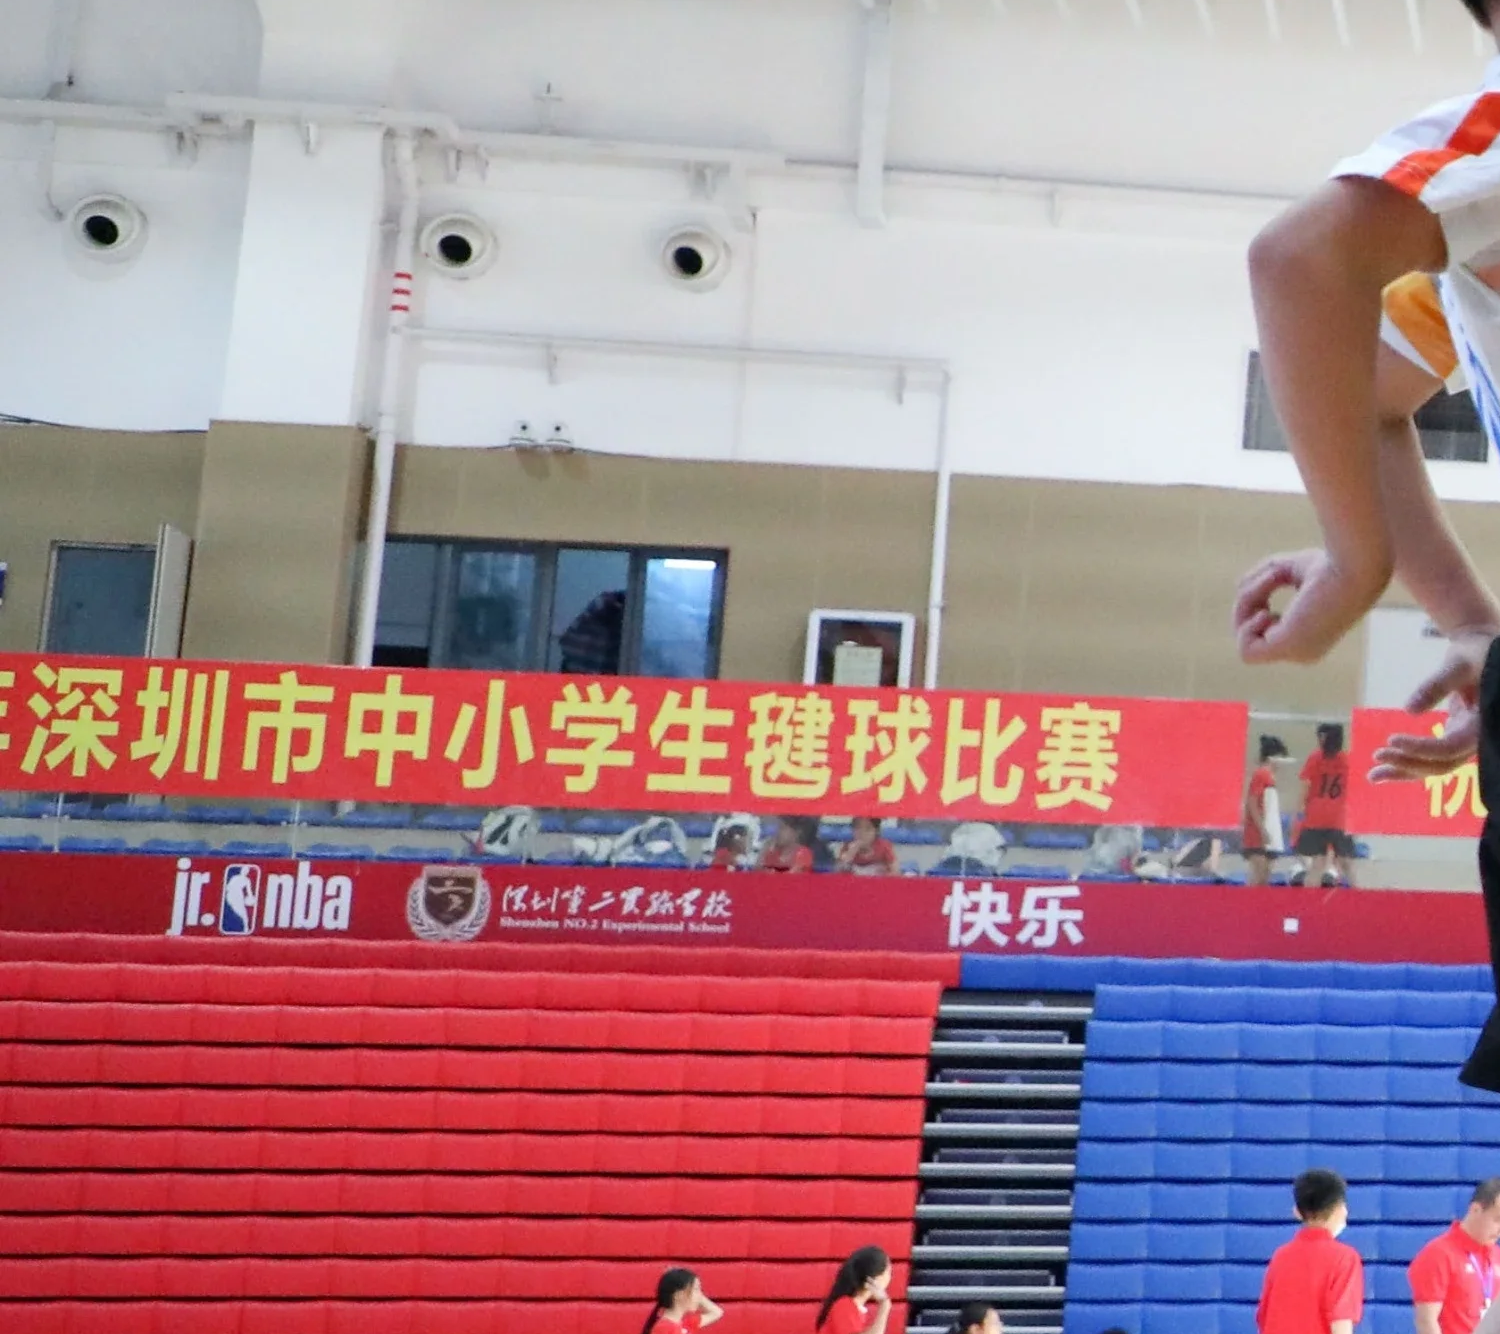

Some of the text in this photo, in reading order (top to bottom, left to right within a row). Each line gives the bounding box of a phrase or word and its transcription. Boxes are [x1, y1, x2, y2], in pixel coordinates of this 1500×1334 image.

[0, 661, 1122, 813] 深圳市中小学生毽球比赛
[1317, 772, 1342, 799] 16
[263, 861, 352, 931] nba
[941, 880, 1084, 948] 快乐
